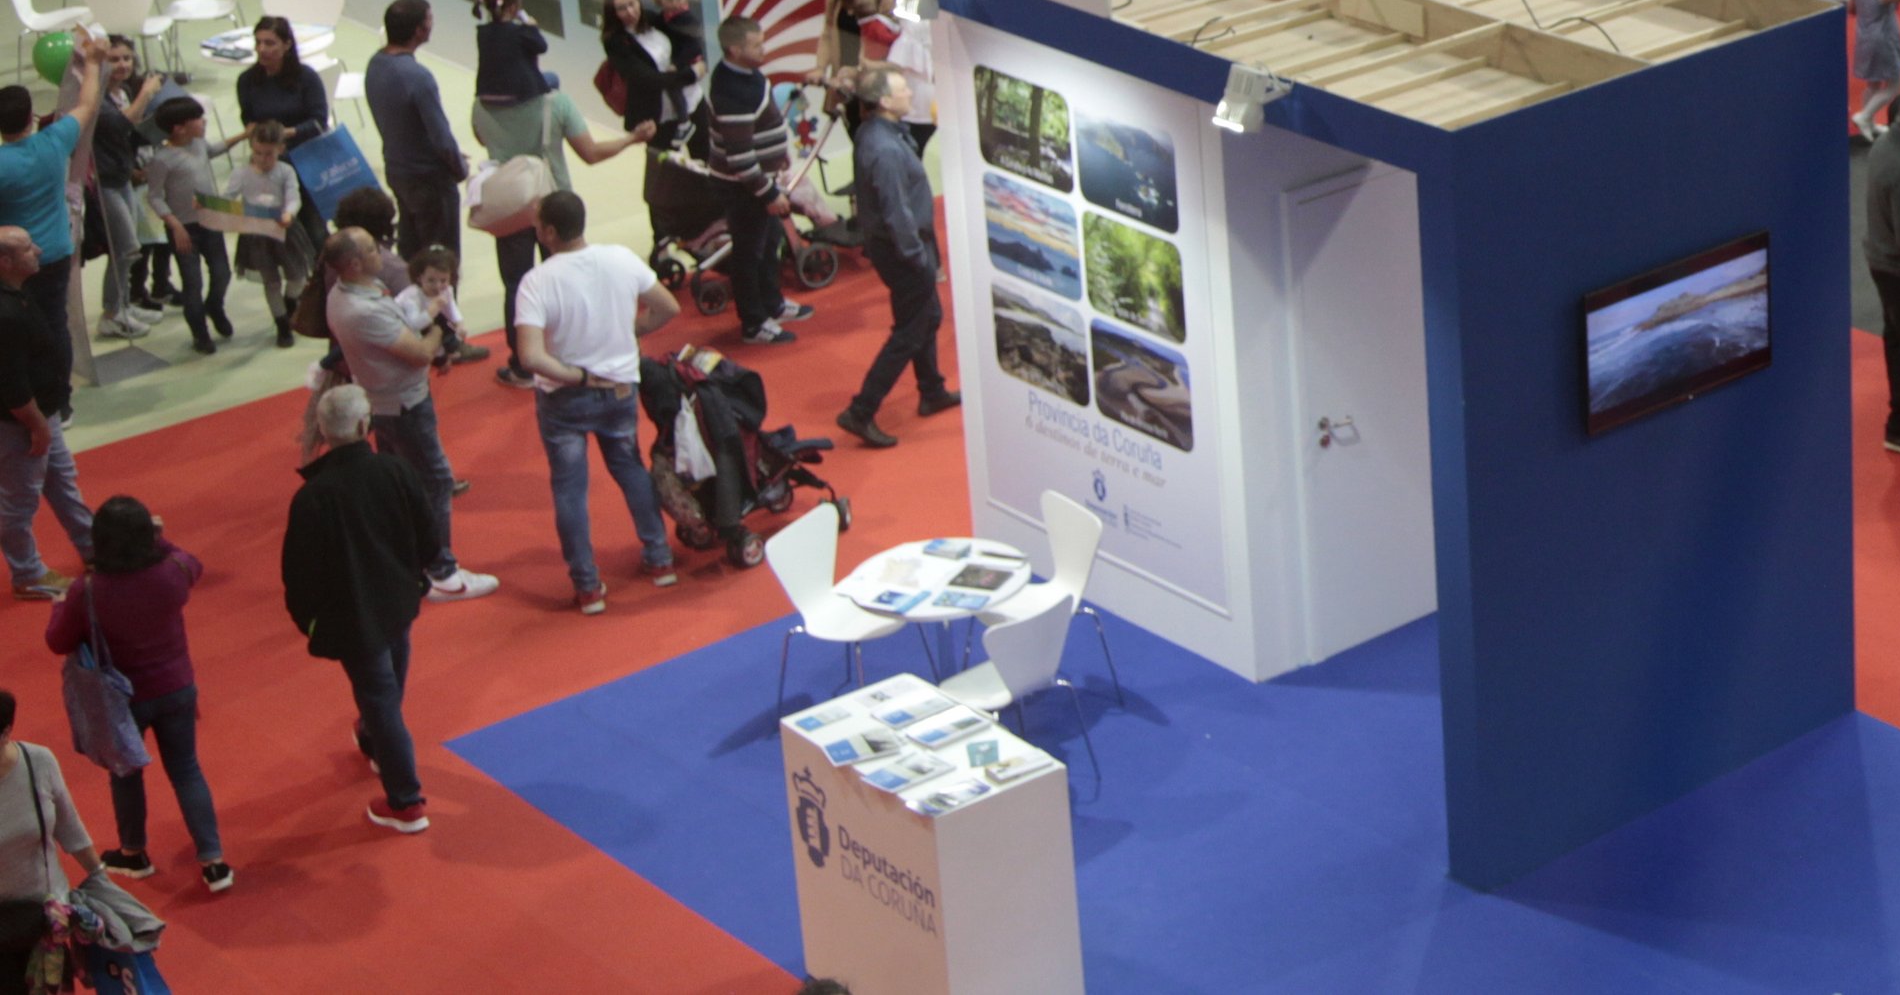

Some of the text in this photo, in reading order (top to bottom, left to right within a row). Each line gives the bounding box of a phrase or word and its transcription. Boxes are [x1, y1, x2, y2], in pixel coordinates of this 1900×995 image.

[1028, 389, 1090, 438] Provincia
[1092, 421, 1109, 447] da
[1112, 427, 1163, 471] Coruña
[838, 824, 936, 908] Deputación
[840, 855, 938, 937] DA CORUÑA
